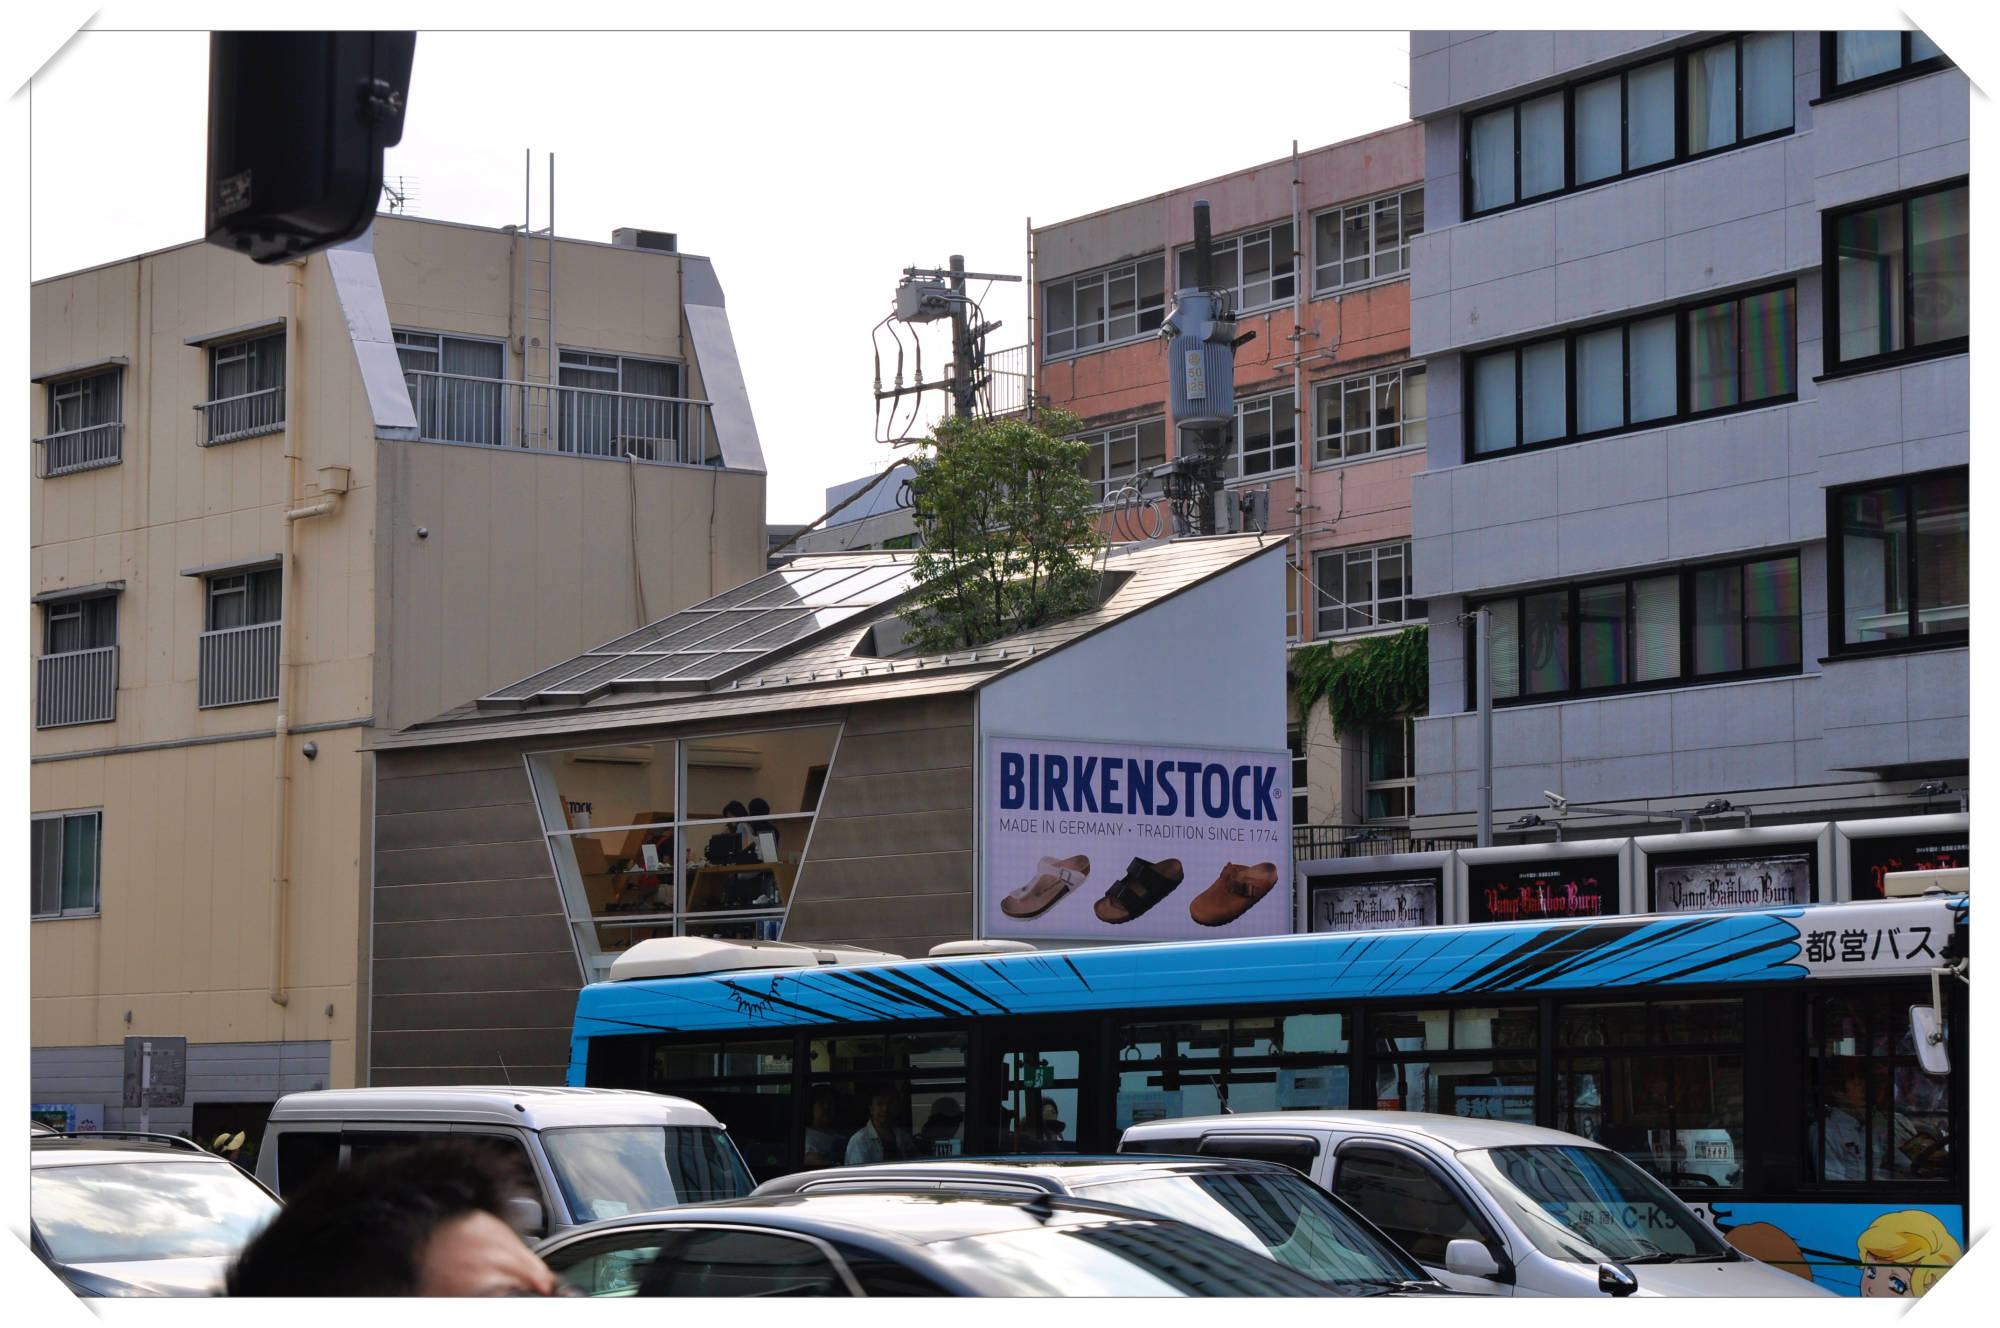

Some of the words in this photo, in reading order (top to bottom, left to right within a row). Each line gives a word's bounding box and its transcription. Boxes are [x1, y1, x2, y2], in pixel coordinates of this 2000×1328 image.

[1000, 751, 1278, 822] BIRKENSTOCK
[999, 818, 1037, 833] MADE
[1042, 820, 1055, 834] IN
[1059, 821, 1124, 836] GERMANY
[1137, 823, 1203, 839] TRADITION
[1208, 828, 1245, 842] SINCE
[1250, 829, 1278, 843] 1774
[1806, 927, 1935, 963] 都営バス
